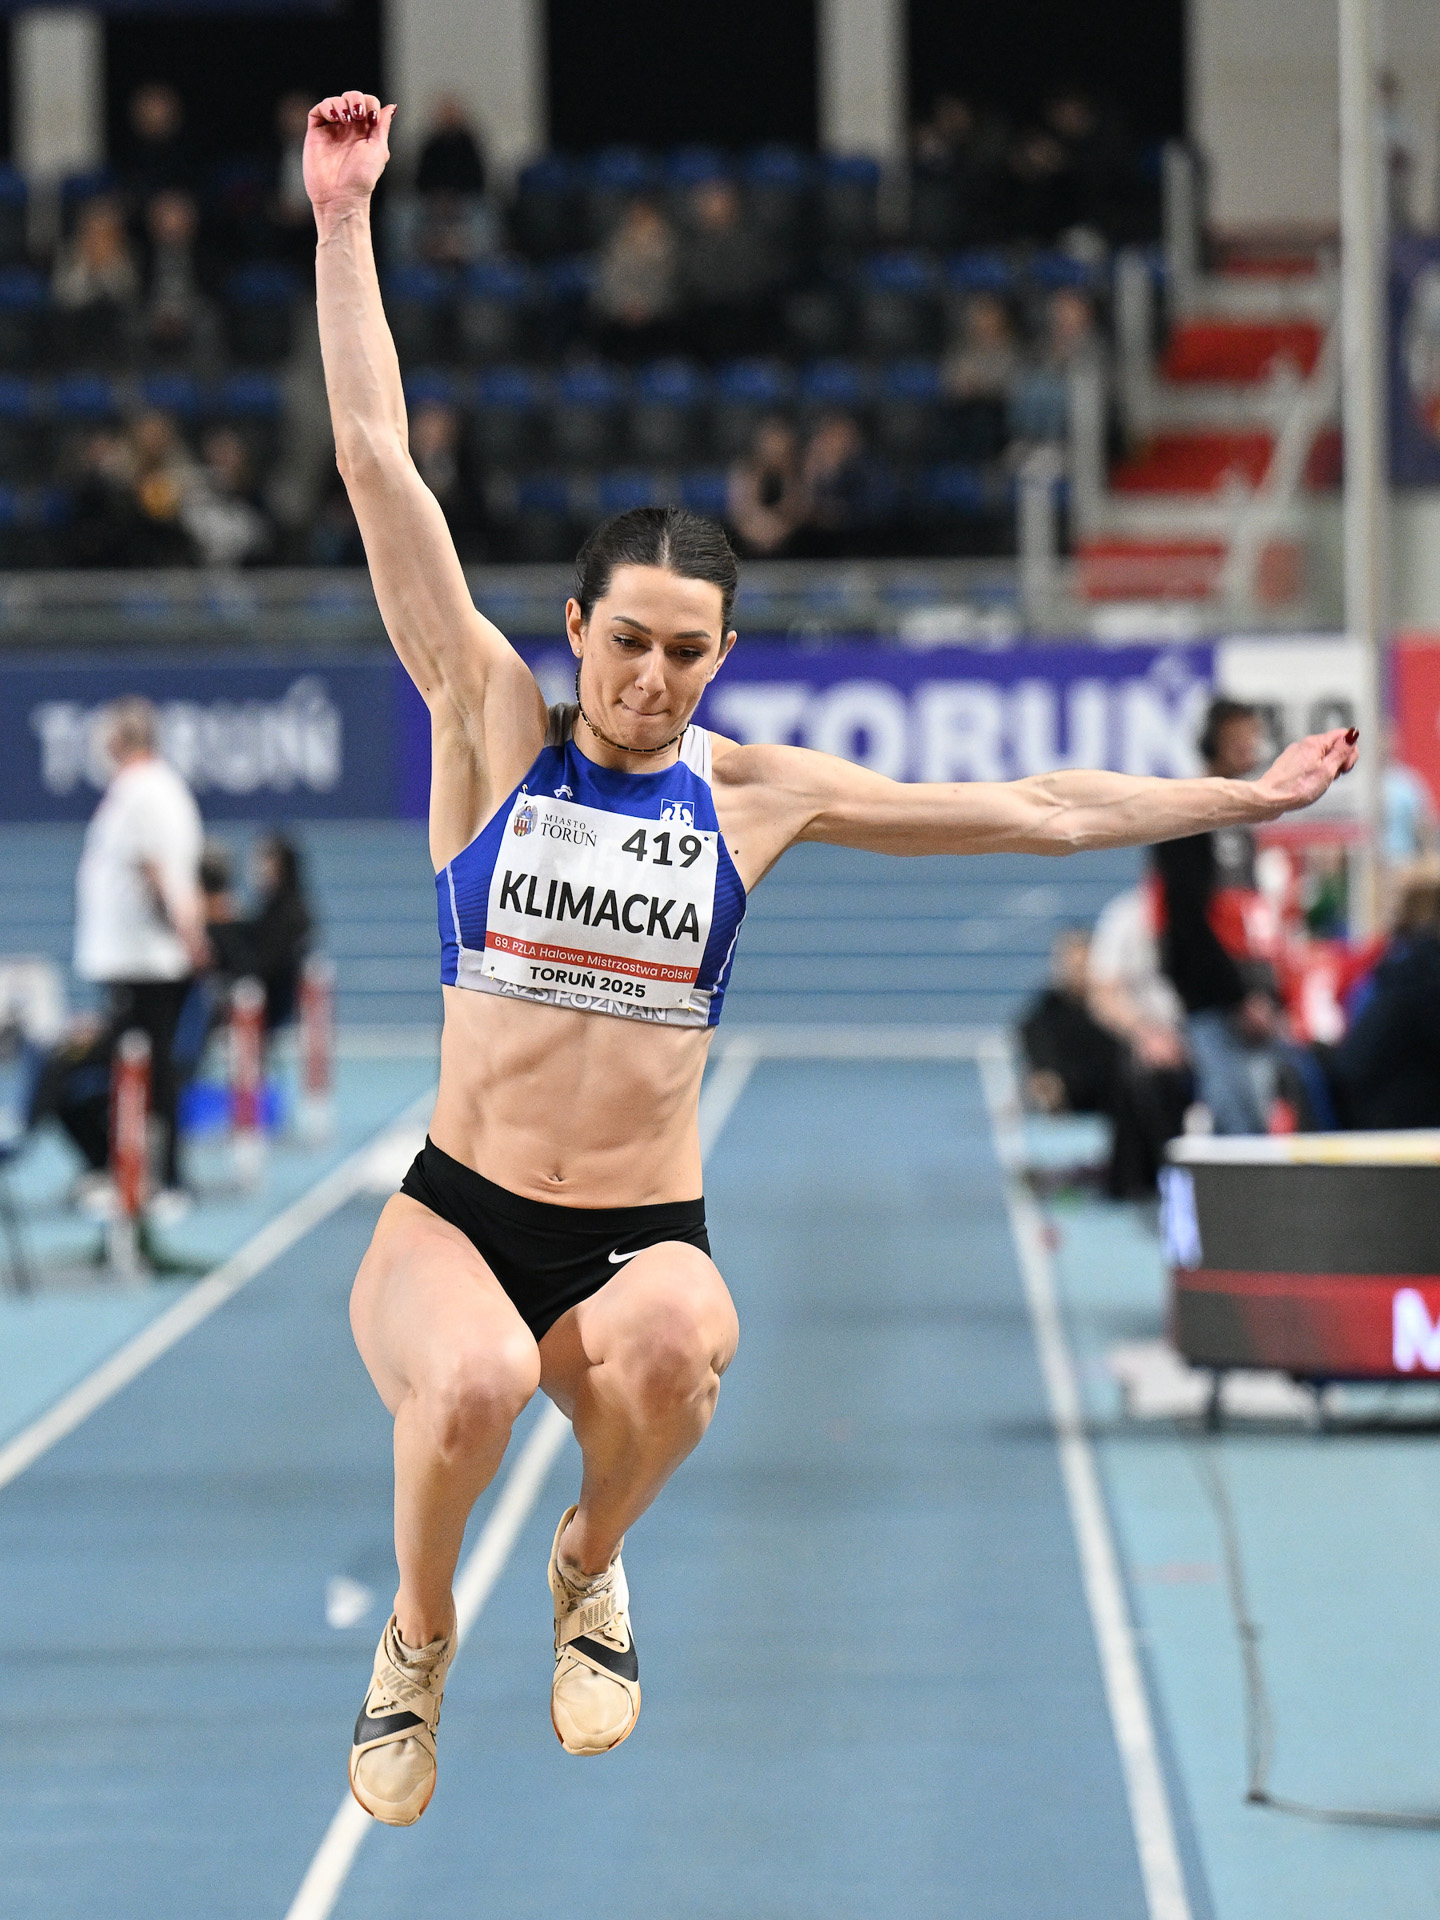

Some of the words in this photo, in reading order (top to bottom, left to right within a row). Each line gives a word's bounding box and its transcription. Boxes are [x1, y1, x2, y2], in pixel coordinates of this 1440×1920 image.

[540, 822, 598, 848] TORUŃ
[544, 813, 586, 831] MIASTO
[621, 828, 703, 869] 419
[499, 869, 700, 943] KLIMACKA
[494, 936, 511, 949] 69.
[511, 940, 537, 957] PZLA
[539, 947, 585, 964] Halowe
[586, 955, 658, 977] Mistrzostwa
[660, 967, 693, 981] Polski
[529, 965, 596, 989] TORUŃ
[599, 976, 647, 999] 2025
[579, 1590, 617, 1633] NIKE
[379, 1664, 424, 1703] NIKE
